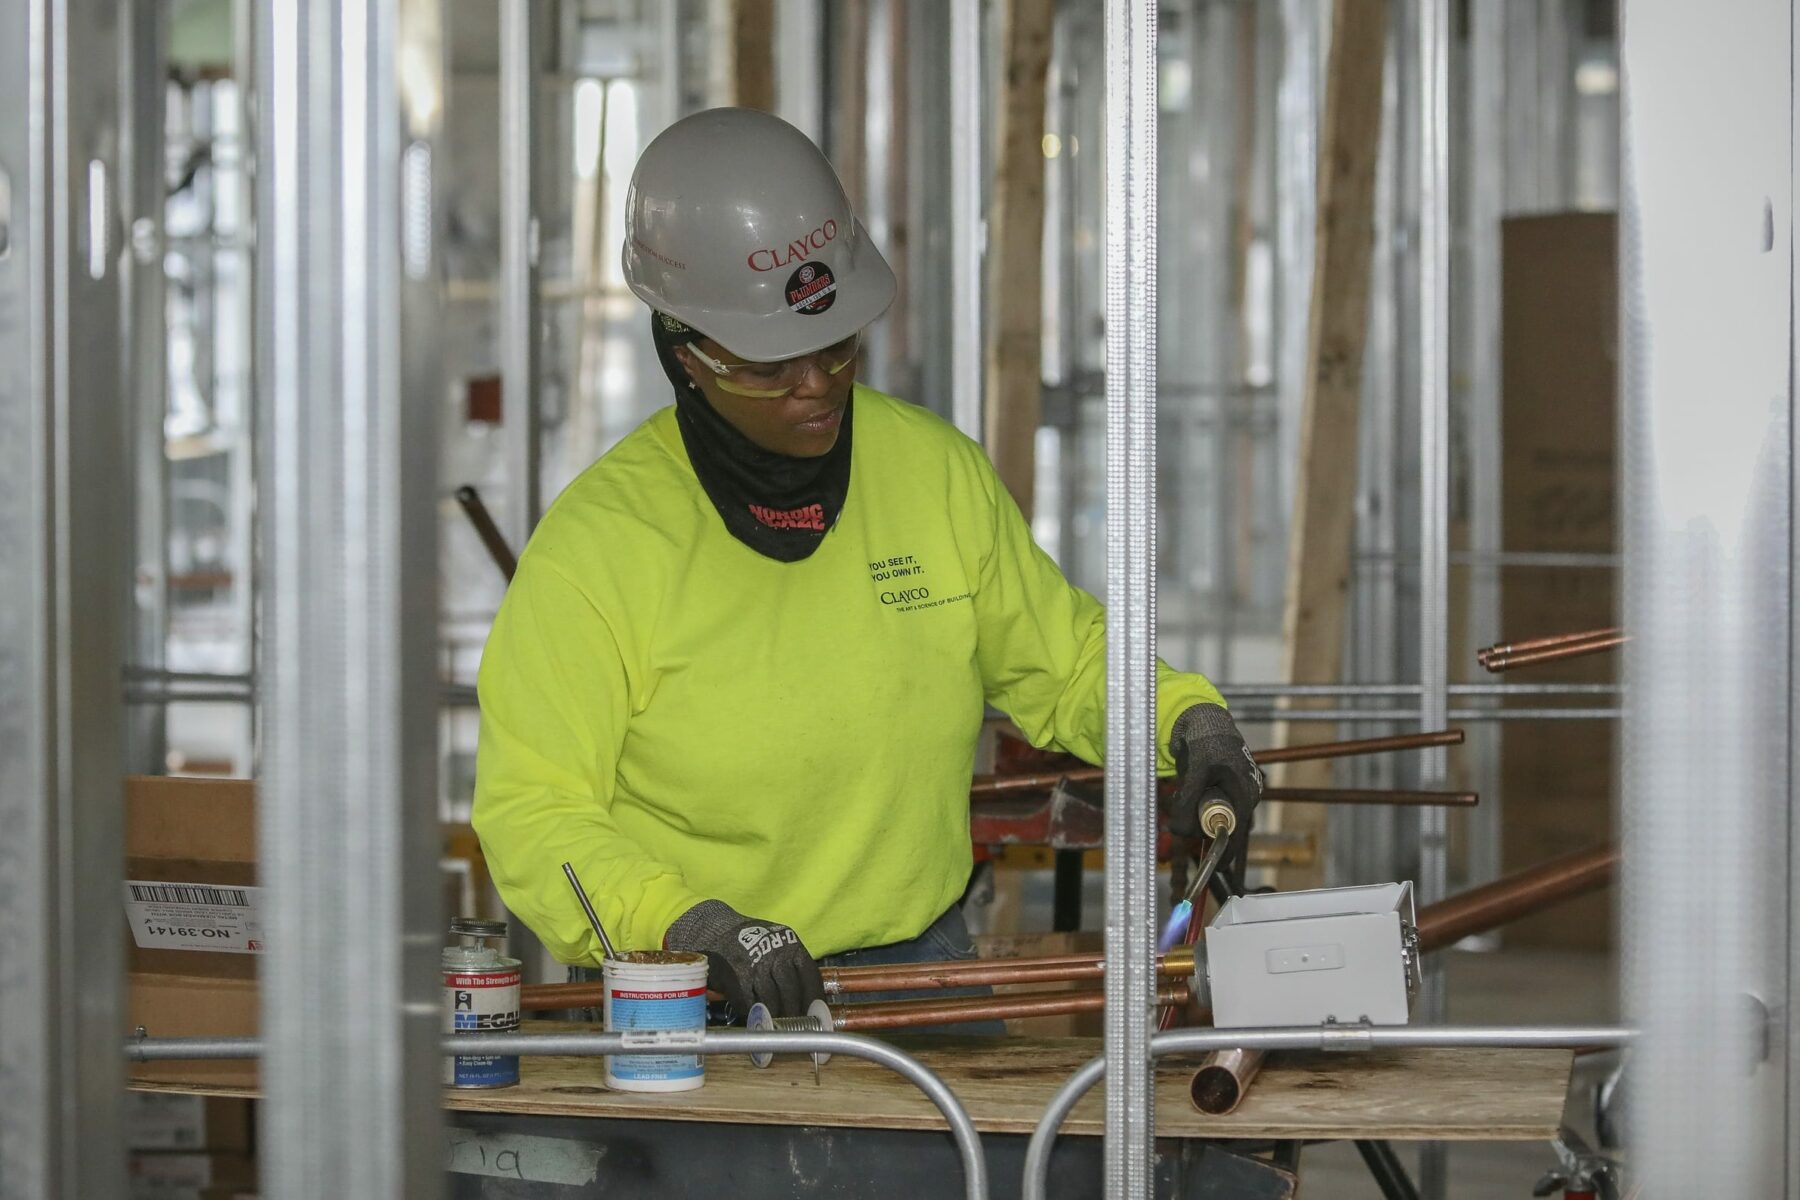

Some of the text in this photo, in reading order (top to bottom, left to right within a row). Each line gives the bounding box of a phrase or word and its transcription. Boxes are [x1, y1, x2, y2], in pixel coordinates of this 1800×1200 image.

[747, 219, 837, 272] CLAYCO
[888, 558, 904, 567] SEE
[871, 571, 891, 583] YOU
[892, 567, 911, 578] OWN
[880, 587, 929, 605] CLAYCO
[742, 927, 761, 943] A3
[456, 977, 471, 986] With
[472, 977, 485, 985] The
